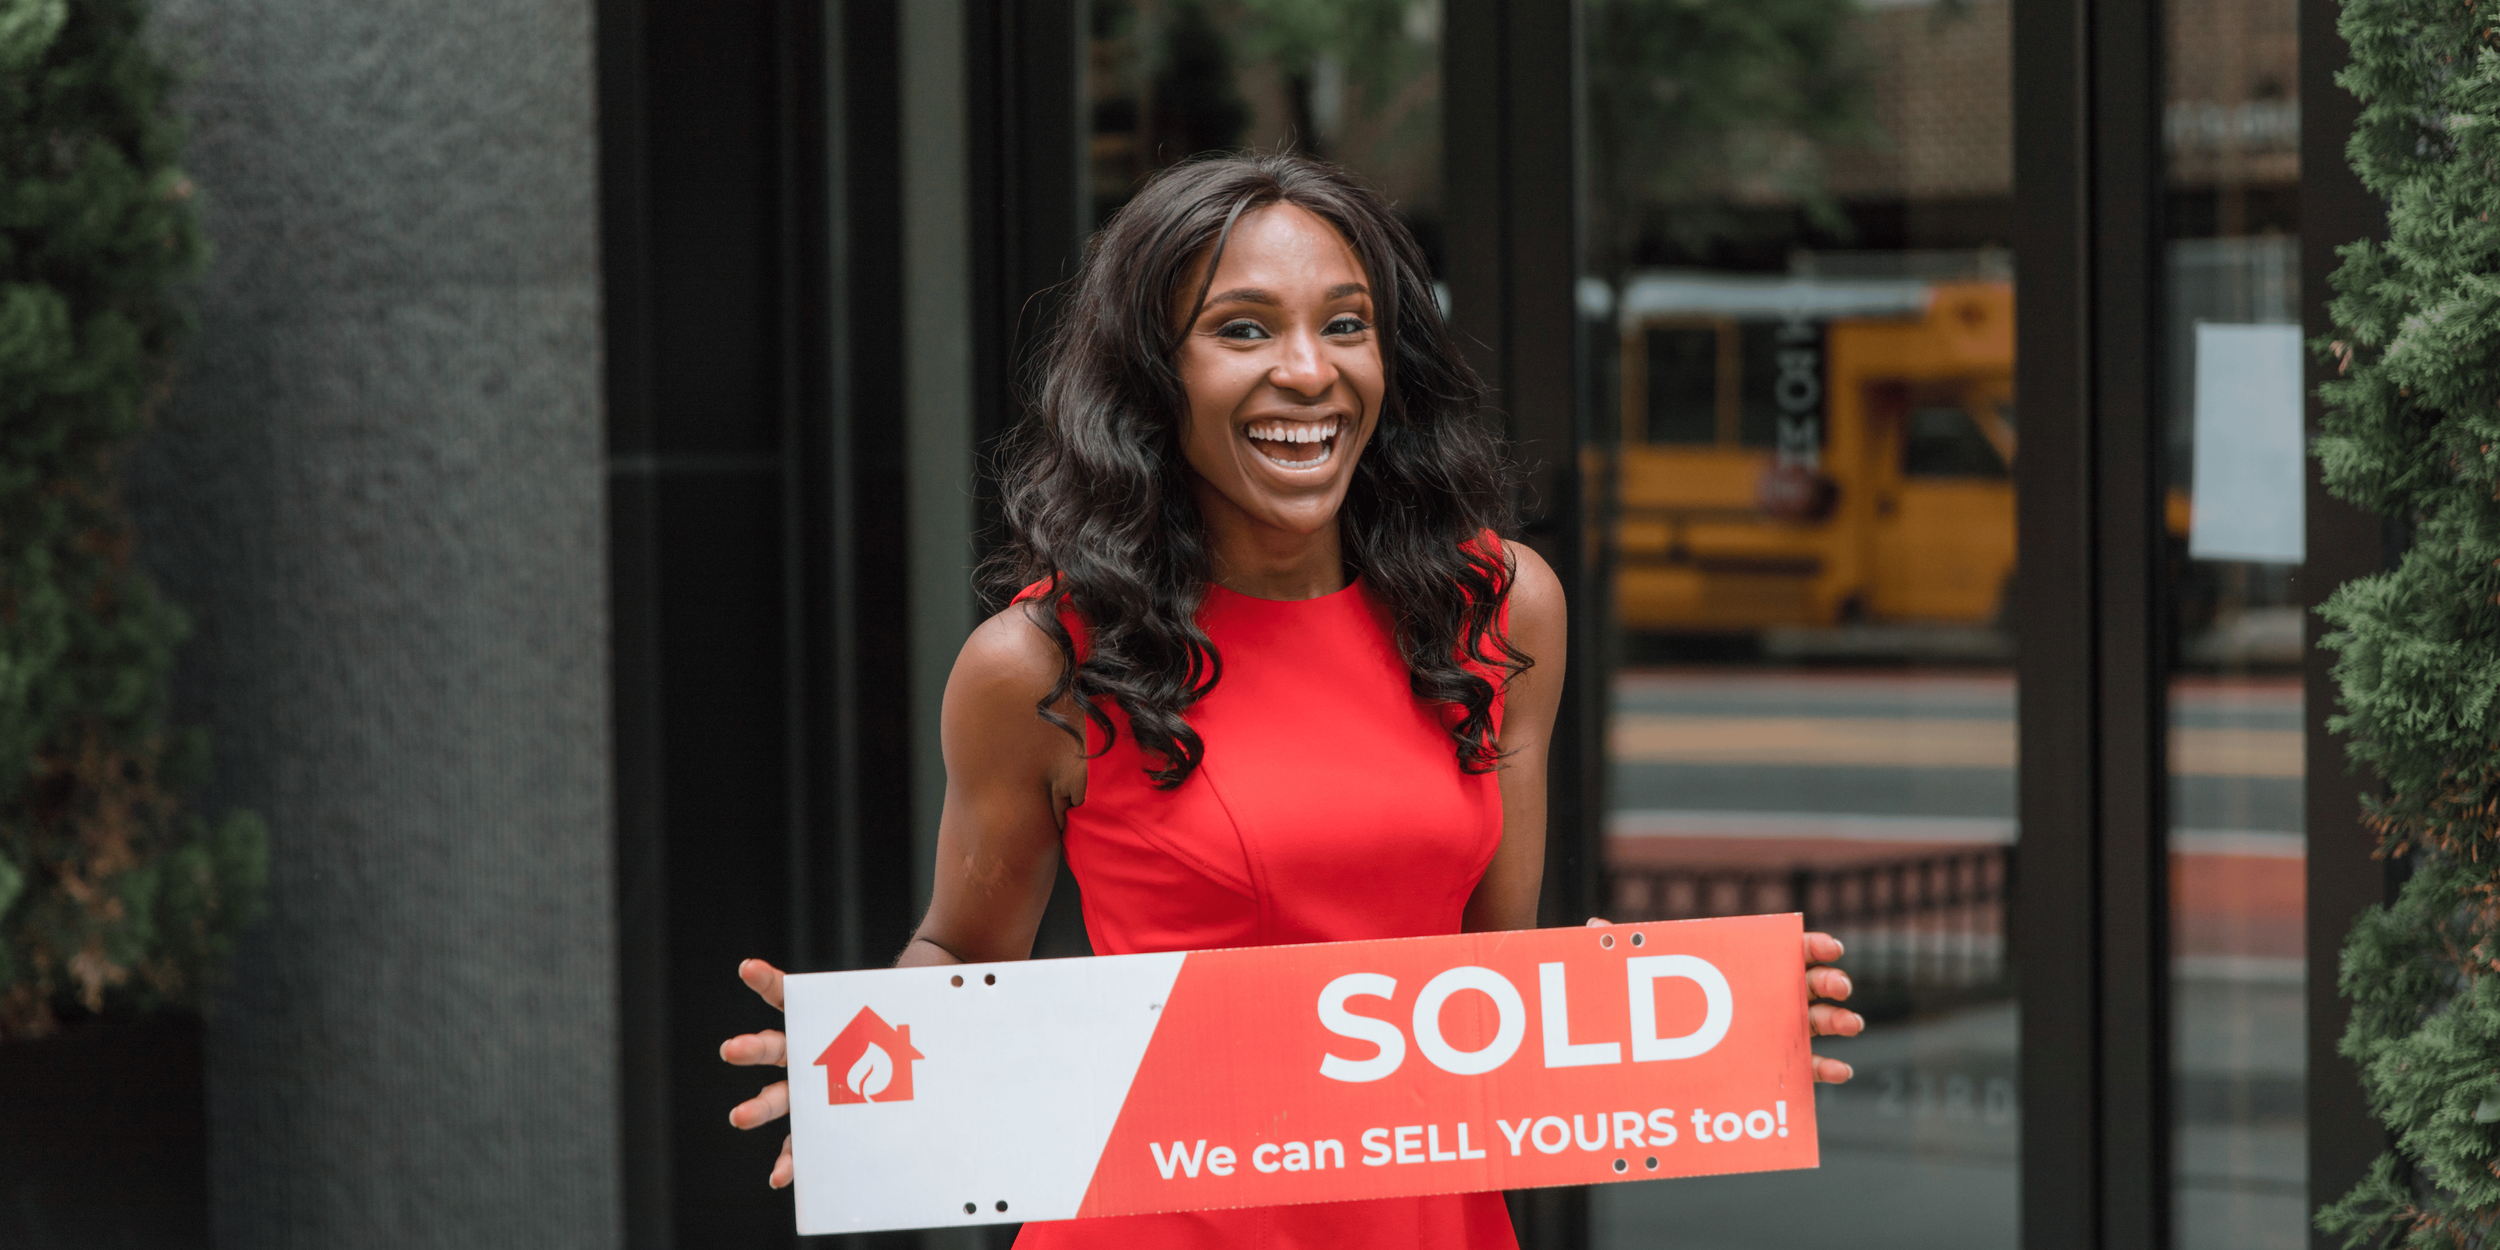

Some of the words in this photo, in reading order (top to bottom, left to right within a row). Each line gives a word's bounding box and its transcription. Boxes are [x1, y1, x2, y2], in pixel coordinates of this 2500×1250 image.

[1317, 954, 1734, 1083] SOLD
[1149, 1139, 1237, 1180] We
[1252, 1137, 1345, 1174] can
[1361, 1122, 1487, 1168] SELL
[1496, 1107, 1679, 1157] YOURS
[1690, 1100, 1789, 1145] too!
